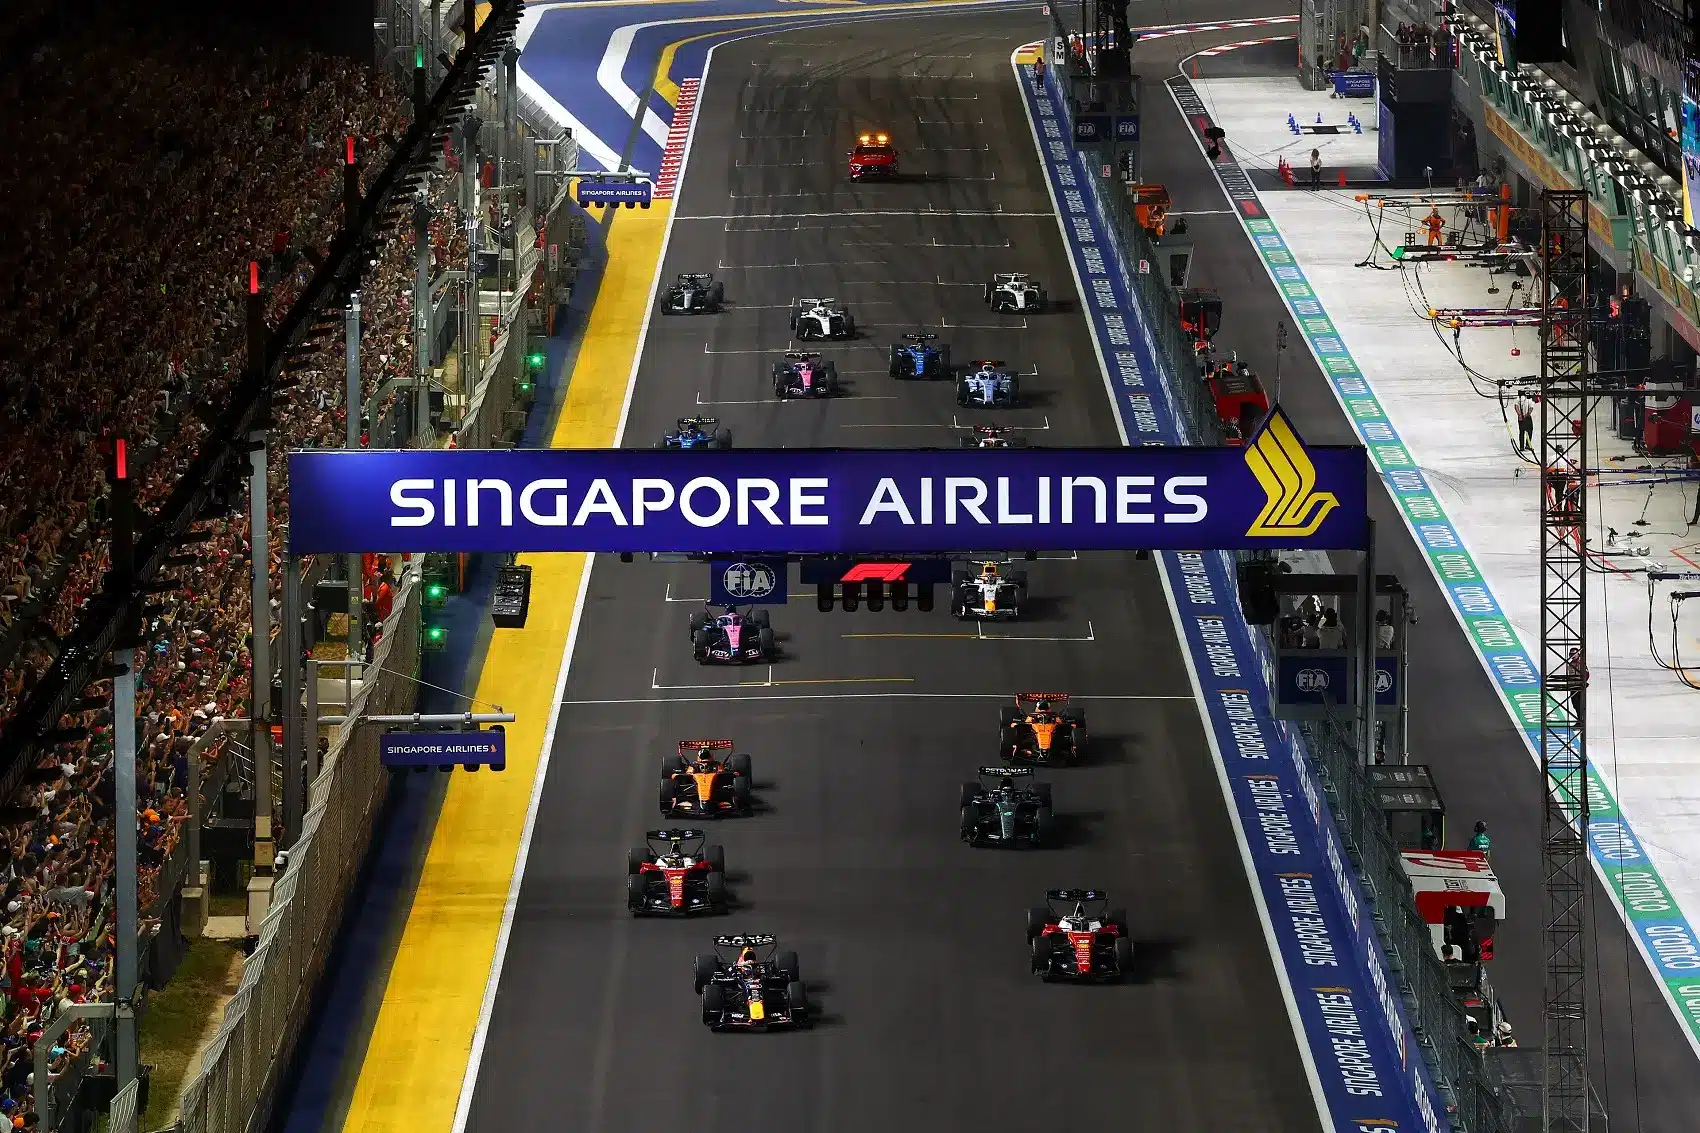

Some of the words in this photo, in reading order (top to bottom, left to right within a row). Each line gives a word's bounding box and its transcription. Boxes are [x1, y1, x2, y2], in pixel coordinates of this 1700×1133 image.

[389, 476, 828, 528] SINGAPORE
[858, 476, 1208, 525] AIRLINES
[1472, 620, 1515, 647] aramco
[1206, 644, 1241, 677] SINGAPORE
[1492, 656, 1537, 684] aramco
[1220, 693, 1256, 722] AIRLINES
[387, 745, 442, 754] SINGAPORE
[446, 745, 489, 753] AIRLINES
[1231, 722, 1270, 760] SINGAPORE
[1248, 779, 1286, 812] AIRLINES
[1258, 812, 1300, 855] SINGAPORE
[1588, 822, 1640, 859] aramco
[1280, 877, 1321, 916] AIRLINES
[1614, 872, 1670, 912] aramco
[1292, 916, 1338, 967] SINGAPORE
[1645, 925, 1700, 969] aramco
[1316, 993, 1363, 1037] AIRLINES
[1331, 1038, 1383, 1096] SINGAPORE
